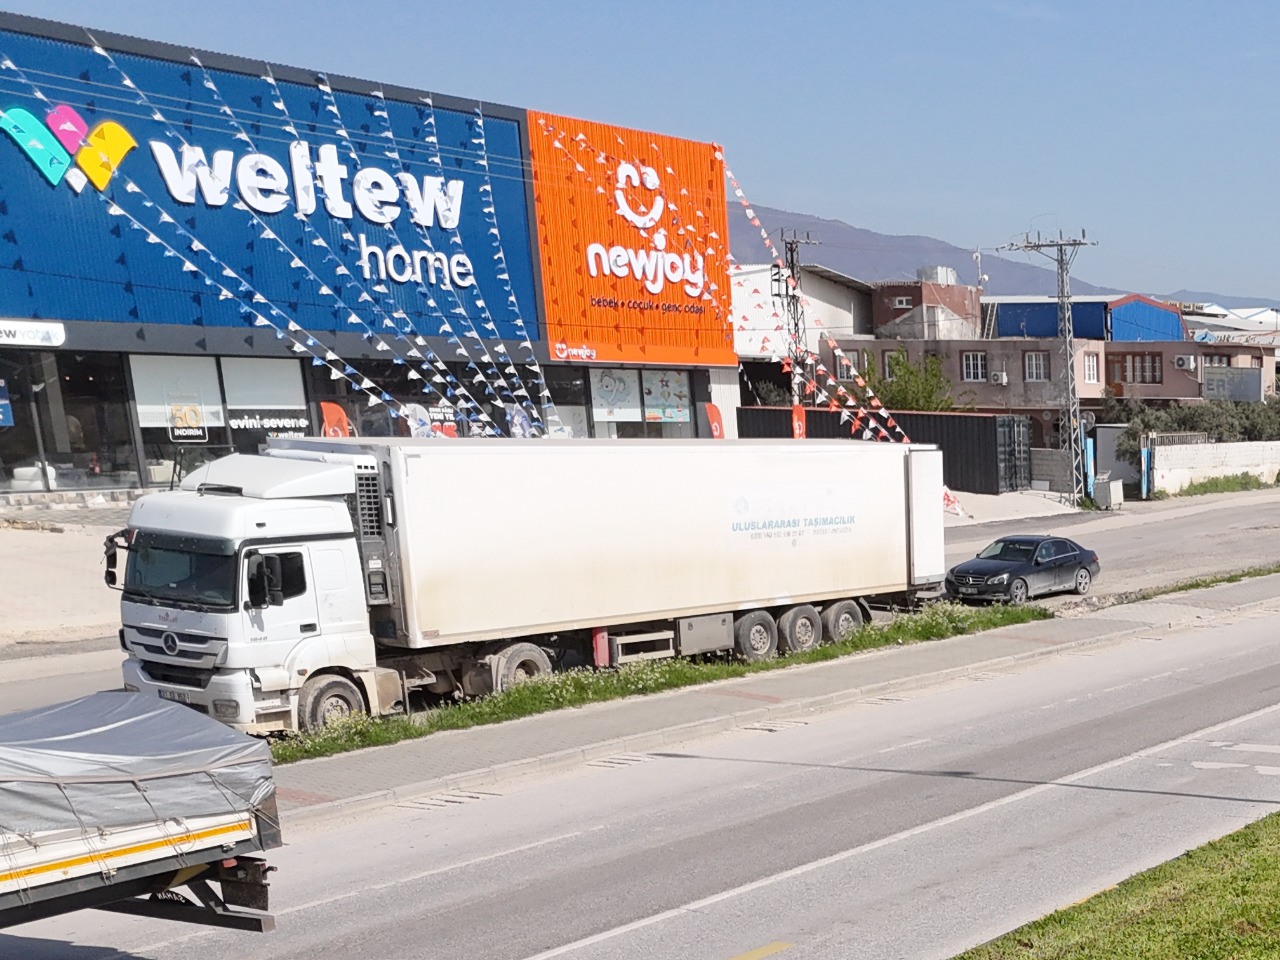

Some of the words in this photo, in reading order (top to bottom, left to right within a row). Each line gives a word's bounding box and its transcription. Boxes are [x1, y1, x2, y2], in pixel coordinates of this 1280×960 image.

[149, 140, 465, 229] weltew
[358, 233, 474, 290] home
[587, 232, 704, 298] newjoy
[590, 295, 619, 308] bebek
[627, 299, 654, 311] çocuk
[661, 302, 682, 314] genç
[567, 345, 596, 359] newjoy
[731, 519, 800, 532] ULUSLARARASI
[803, 515, 856, 528] TAŞIMACILIK
